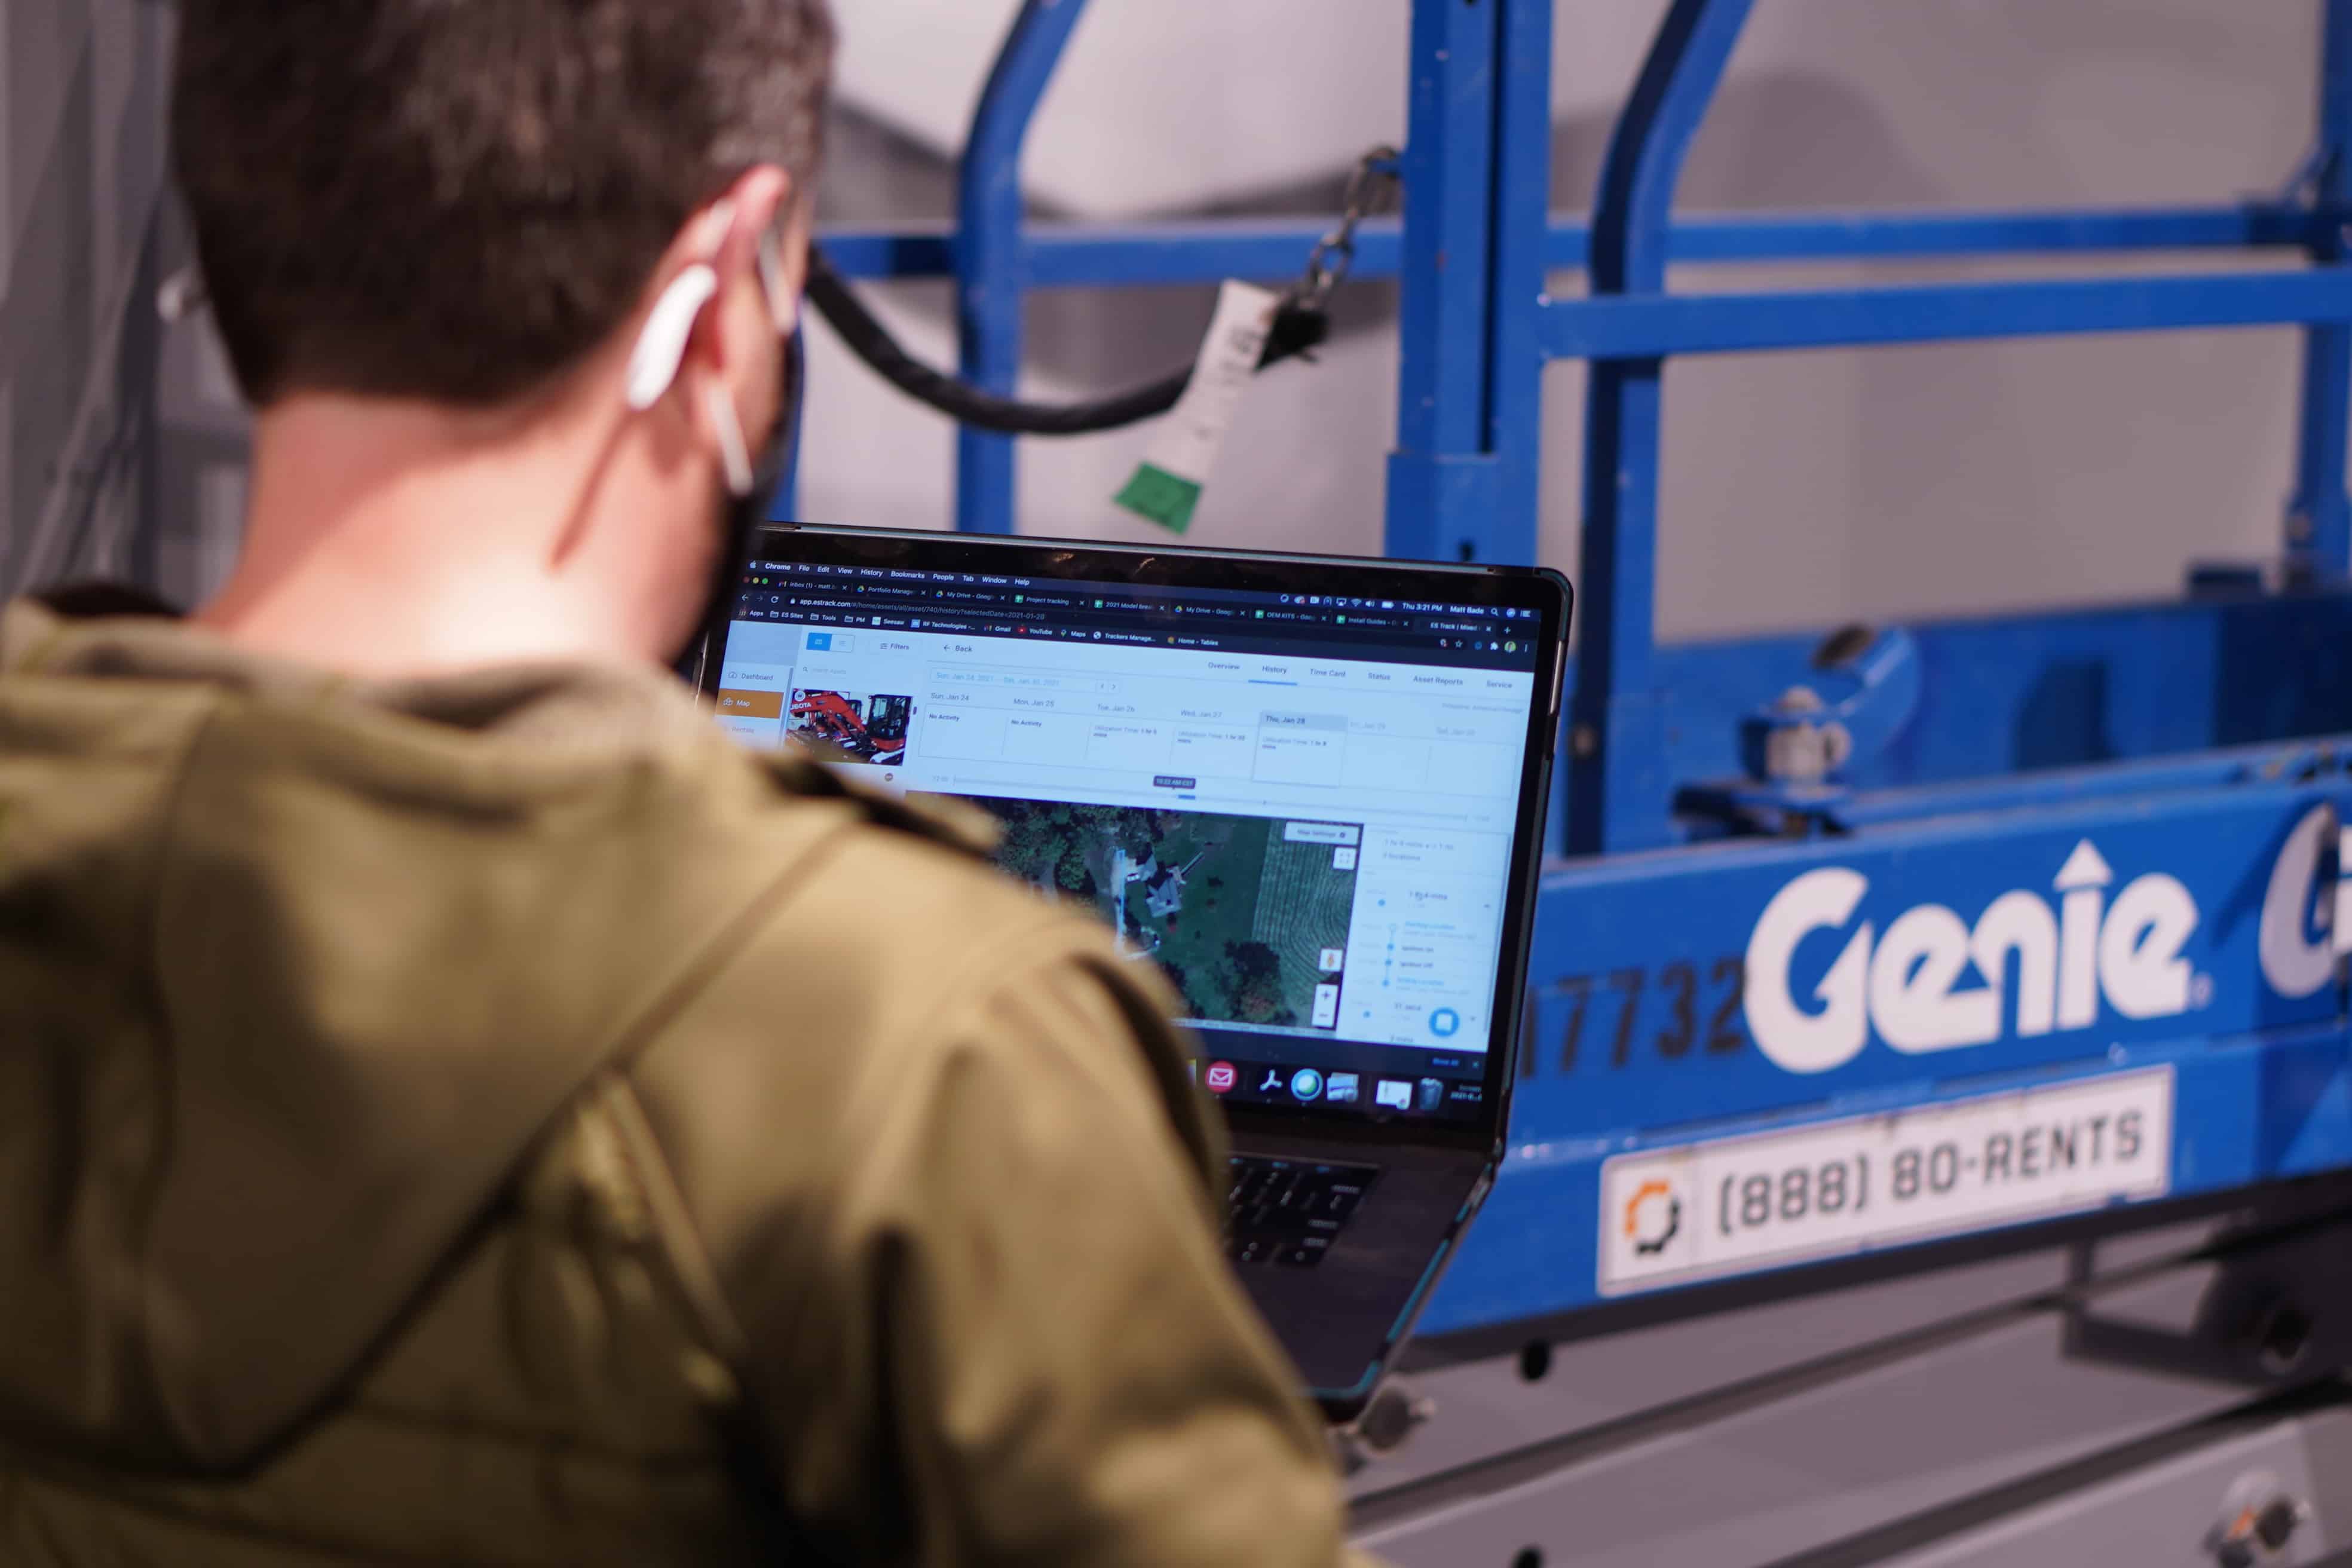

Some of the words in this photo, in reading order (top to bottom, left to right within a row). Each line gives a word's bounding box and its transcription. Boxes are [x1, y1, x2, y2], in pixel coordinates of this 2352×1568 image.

[860, 569, 883, 577] History
[891, 571, 924, 579] Bookmarks
[1026, 596, 1046, 605] Project
[932, 622, 967, 630] Technologies
[1262, 666, 1287, 674] History
[1368, 672, 1391, 681] Status
[1435, 676, 1463, 685] Reports
[1745, 839, 2200, 1073] Genie
[1719, 1152, 1870, 1235] (888)
[1891, 1110, 2143, 1200] 80-RENTS
